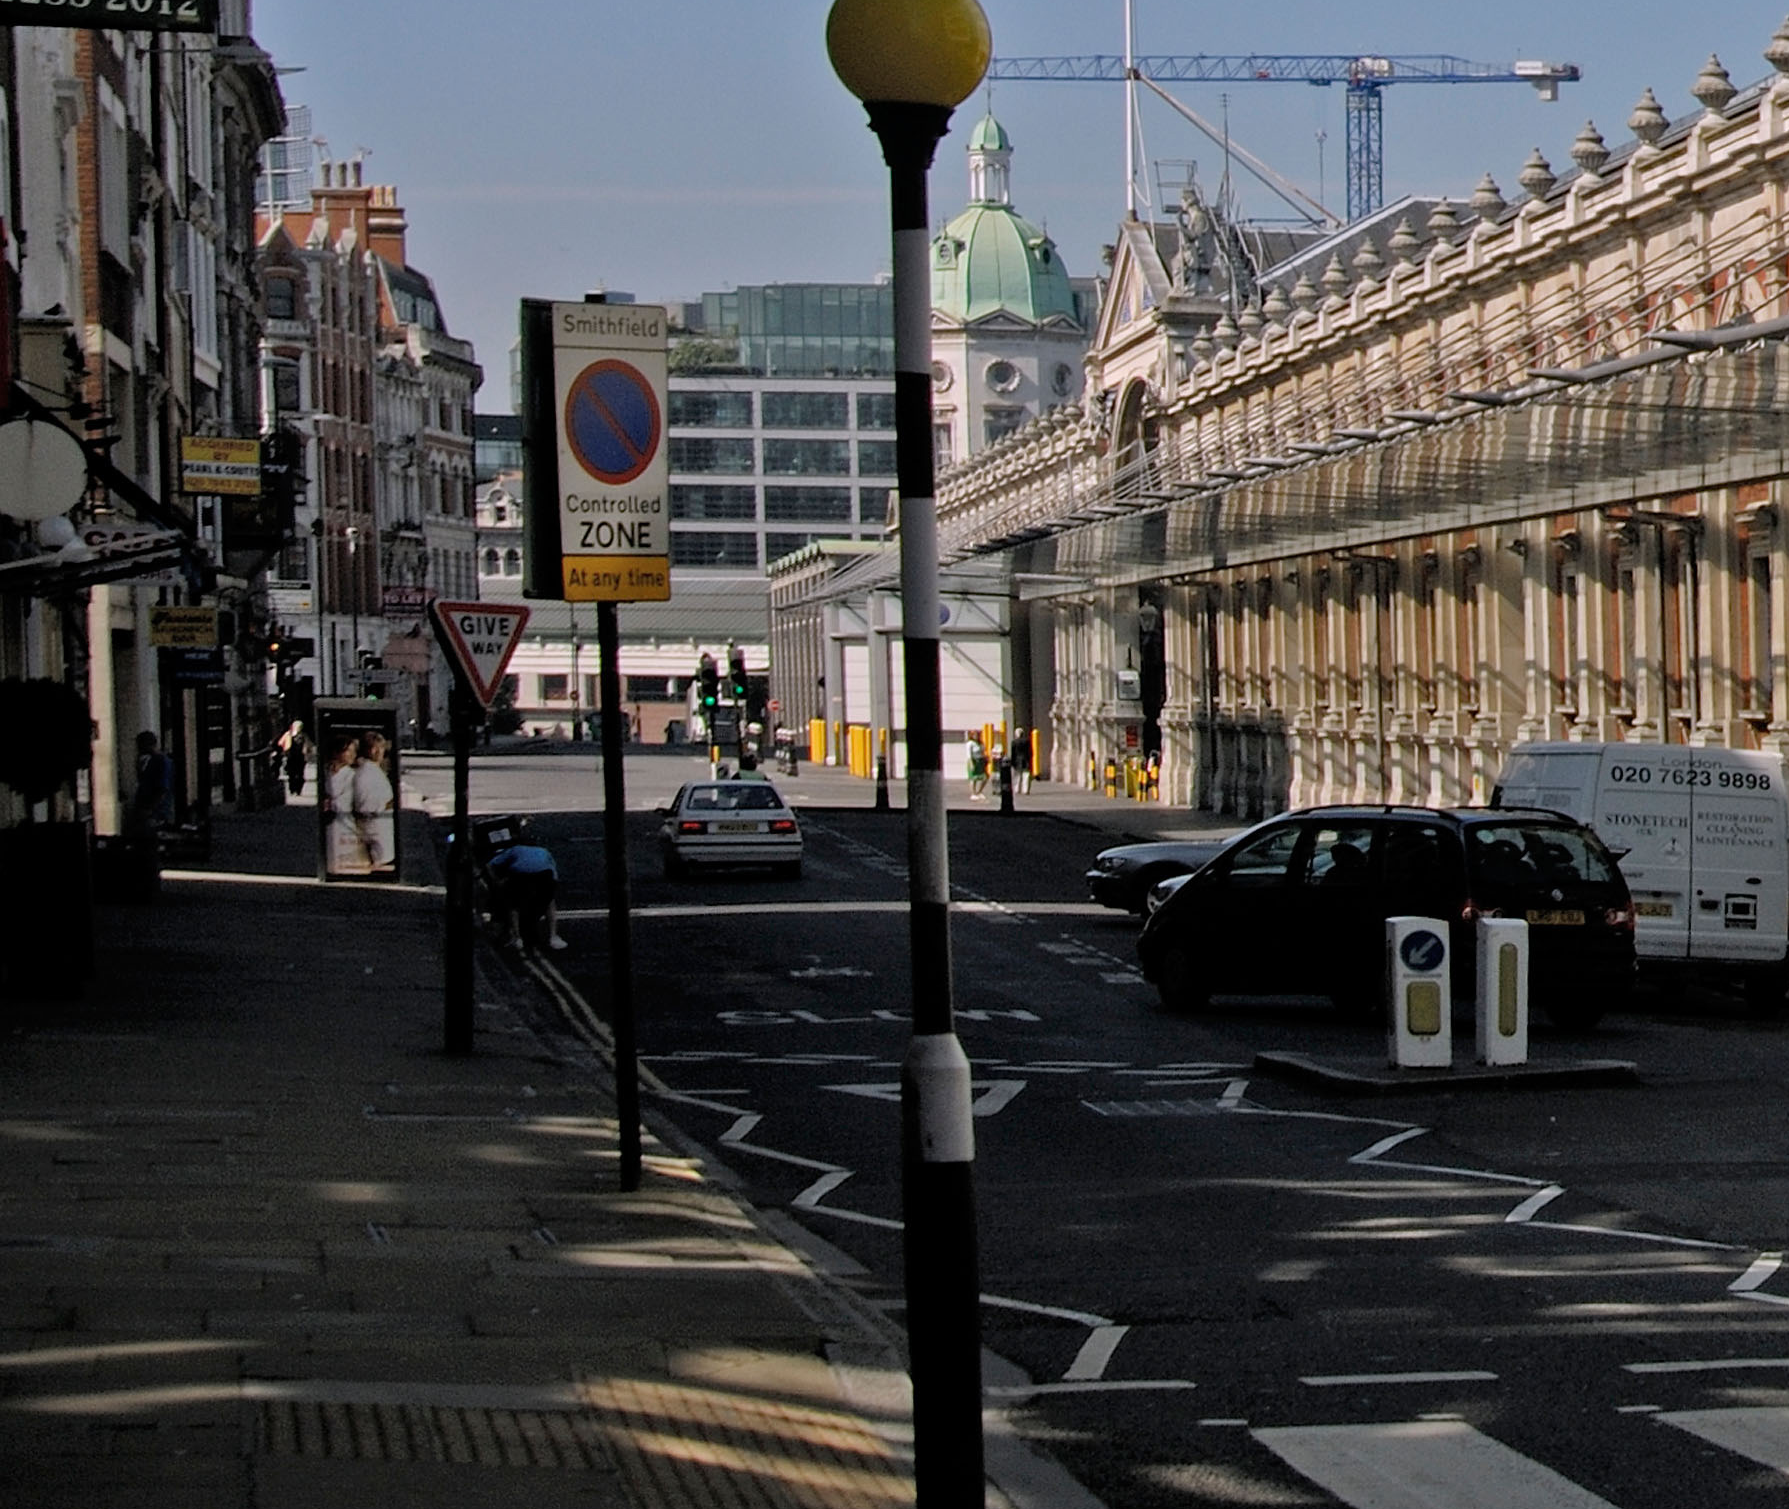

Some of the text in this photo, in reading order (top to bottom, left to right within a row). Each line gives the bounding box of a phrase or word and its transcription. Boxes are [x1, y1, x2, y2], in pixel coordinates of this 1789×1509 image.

[564, 314, 659, 338] Smithfield
[566, 494, 661, 514] Controlled
[580, 521, 651, 548] ZONE
[568, 568, 665, 592] At any time
[460, 616, 509, 636] GIVE
[473, 642, 503, 655] WAY
[1661, 757, 1722, 770] London
[1611, 766, 1771, 790] 020 7623 9898
[1605, 813, 1688, 828] STONETECH
[1697, 811, 1774, 824] RESTORATION
[1706, 825, 1764, 836] CLEANING
[1695, 836, 1775, 849] MAINTENANCE
